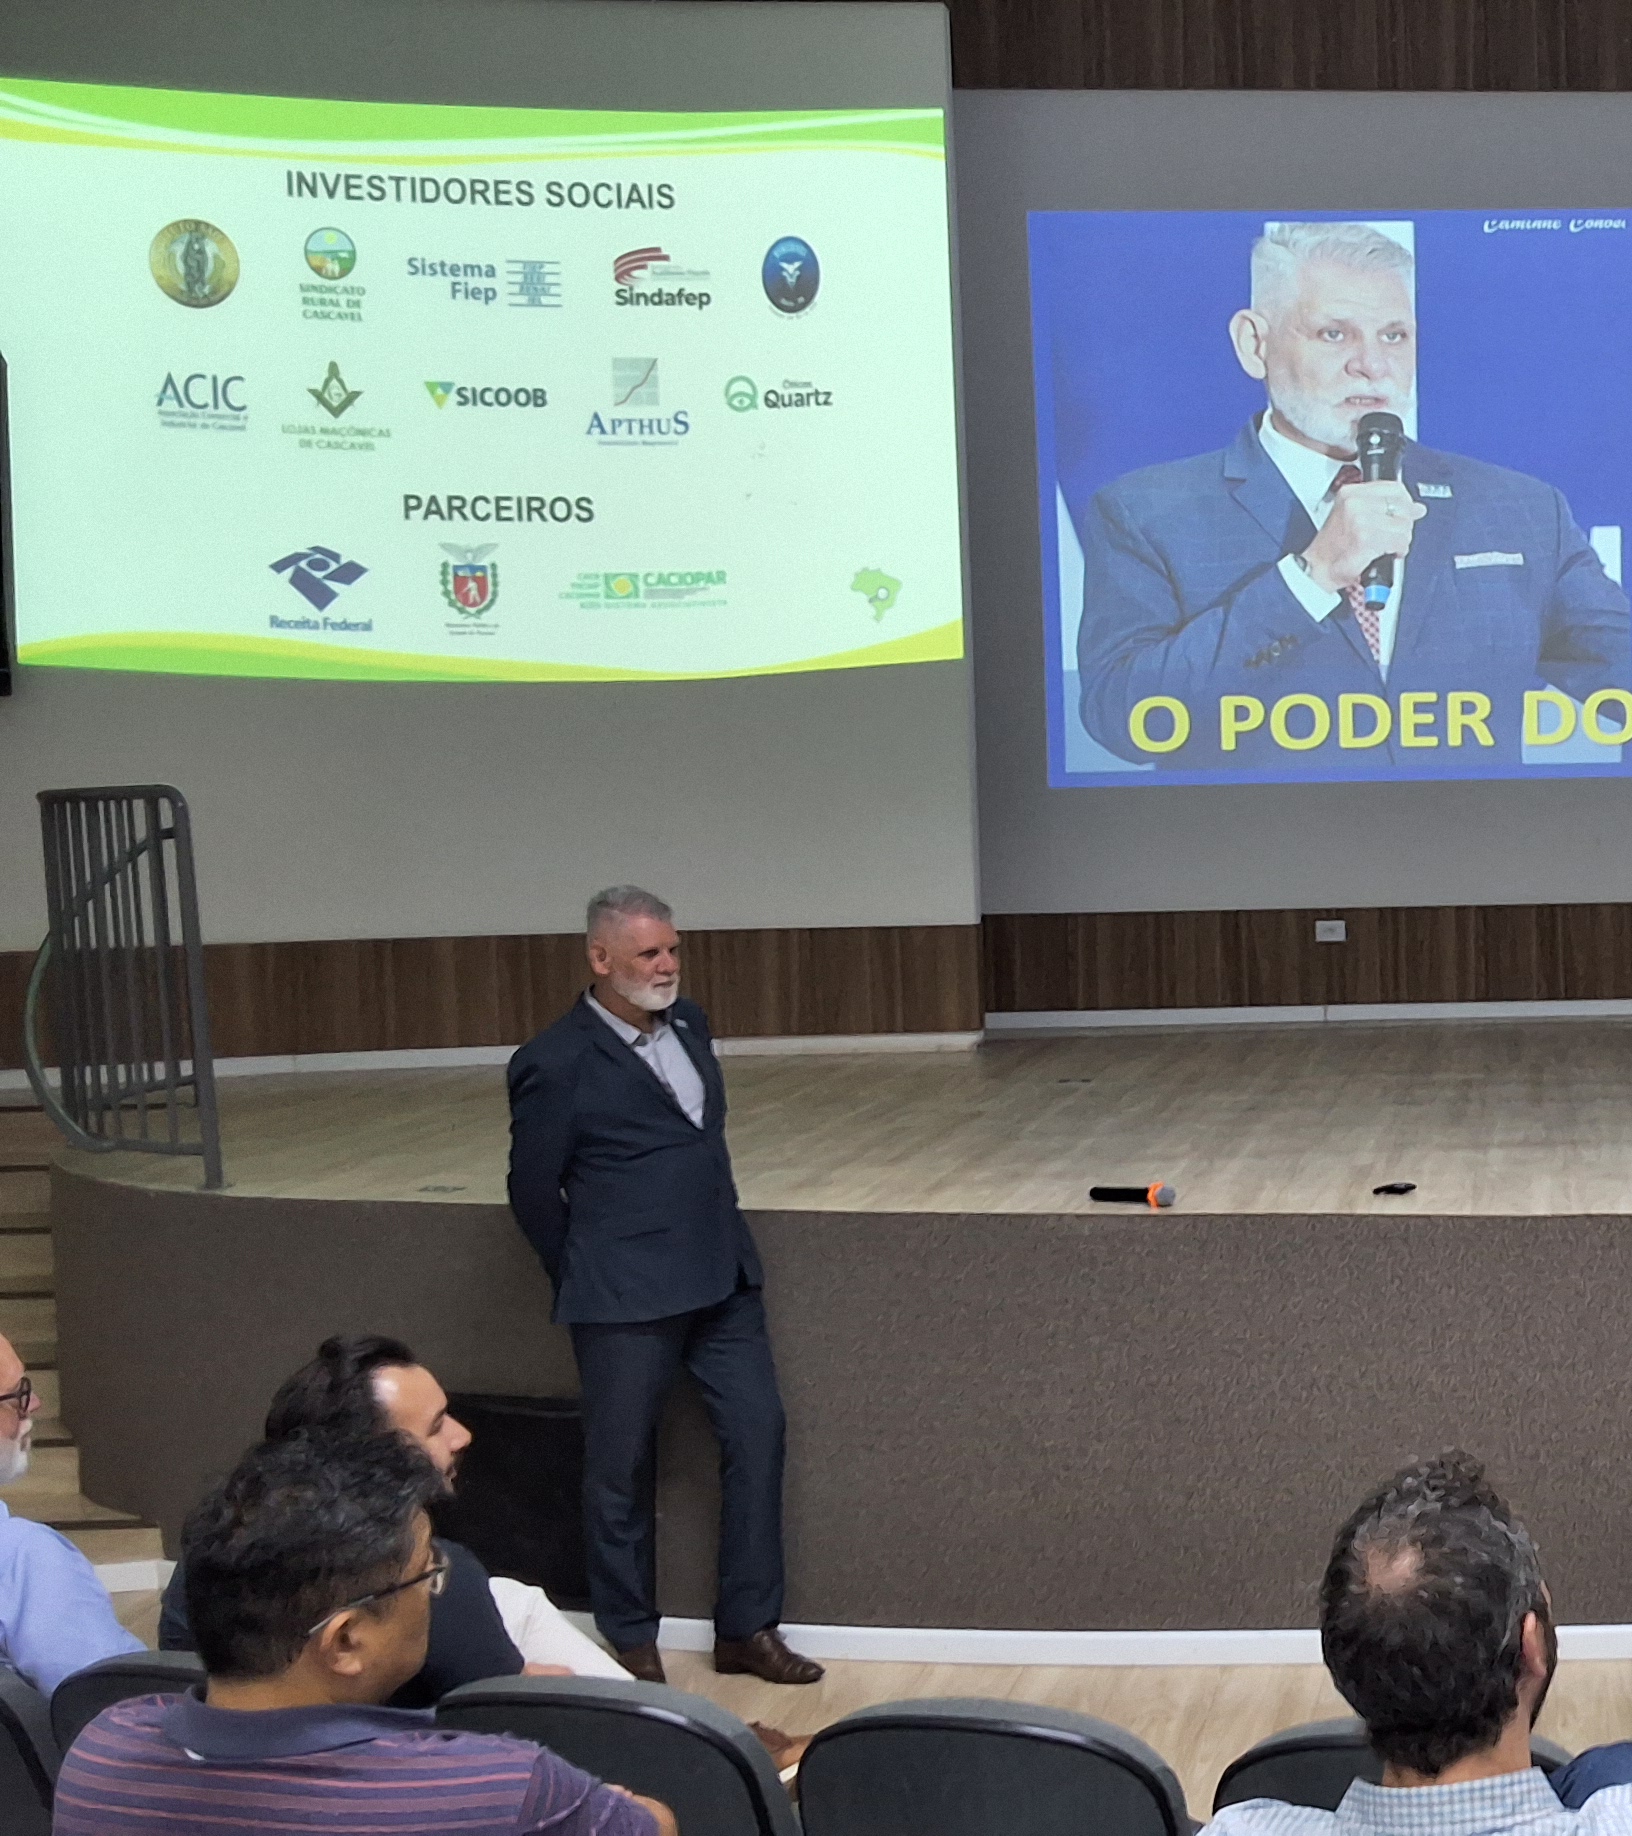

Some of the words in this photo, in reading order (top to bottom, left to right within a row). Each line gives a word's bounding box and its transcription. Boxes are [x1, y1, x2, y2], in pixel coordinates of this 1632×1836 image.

[286, 169, 535, 208] INVESTIDORES
[545, 180, 676, 210] SOCIAIS
[406, 257, 497, 278] Sistema
[450, 281, 498, 306] Fiep
[614, 285, 712, 310] Sindafep
[155, 371, 248, 413] ACIC
[455, 385, 547, 408] SICOOB
[763, 388, 834, 409] Quartz
[402, 494, 596, 523] PARCEIROS
[643, 570, 728, 587] CACIOPAR
[269, 615, 320, 630] Receita
[322, 617, 373, 632] Federal
[1128, 695, 1191, 753] O
[1219, 690, 1495, 751] PODER
